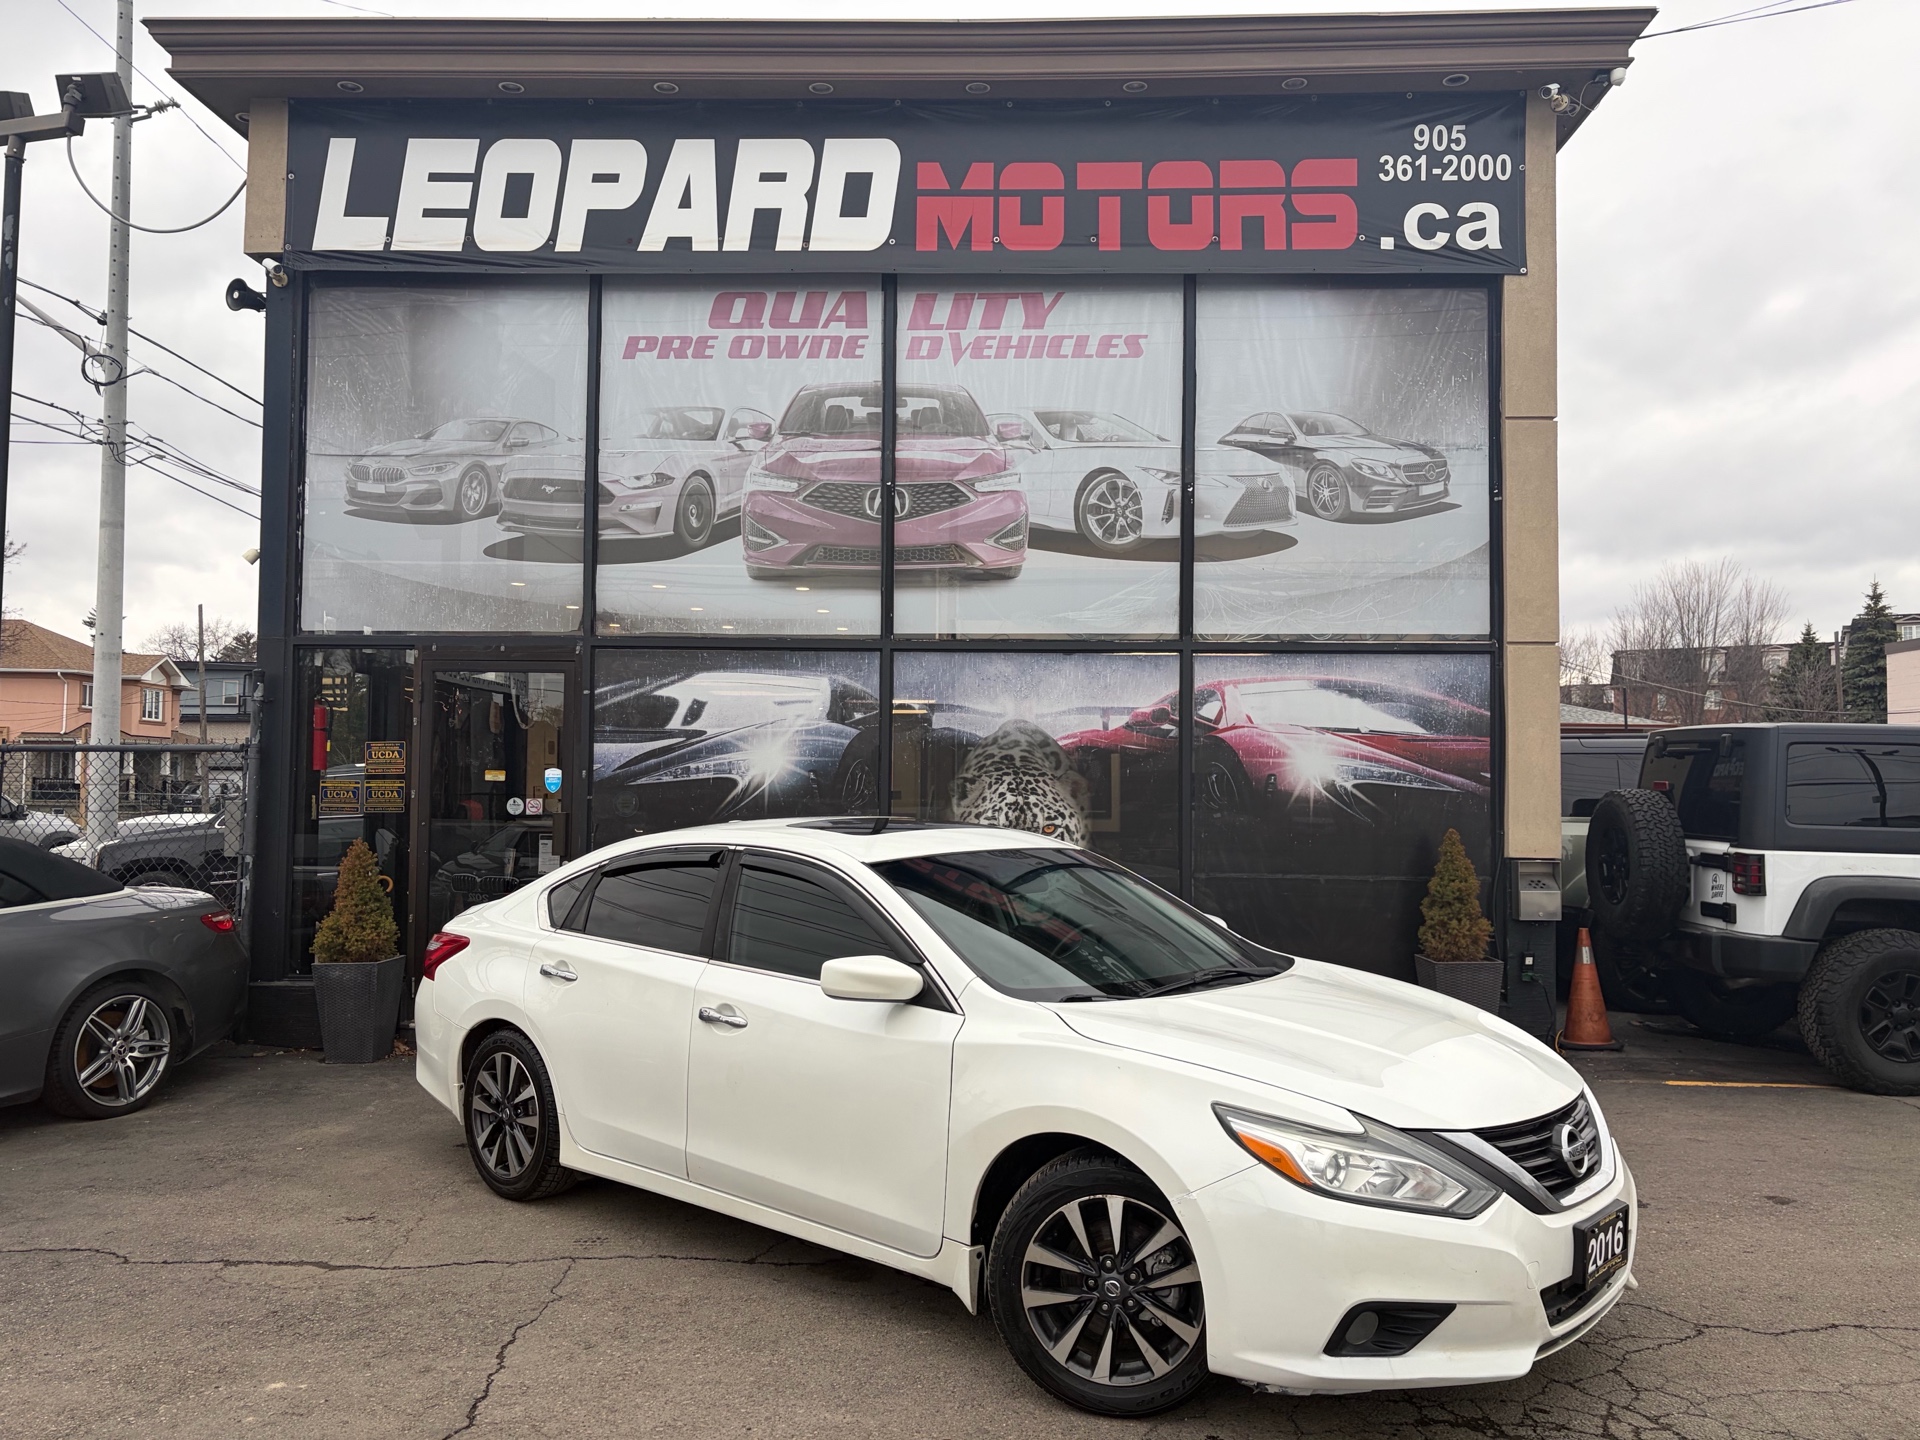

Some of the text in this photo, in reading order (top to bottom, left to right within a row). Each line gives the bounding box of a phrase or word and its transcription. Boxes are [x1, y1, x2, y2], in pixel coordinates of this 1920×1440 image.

[1413, 124, 1467, 151] 905
[1378, 154, 1512, 182] 361-2000
[311, 137, 1358, 252] LEOPARD MOTORS
[1380, 202, 1503, 250] .ca
[622, 335, 719, 360] PRE
[371, 750, 400, 759] UCDA
[327, 790, 354, 798] UCDA
[371, 790, 398, 798] UCDA
[1711, 883, 1725, 892] WHEEL
[1587, 1220, 1624, 1274] 2016
